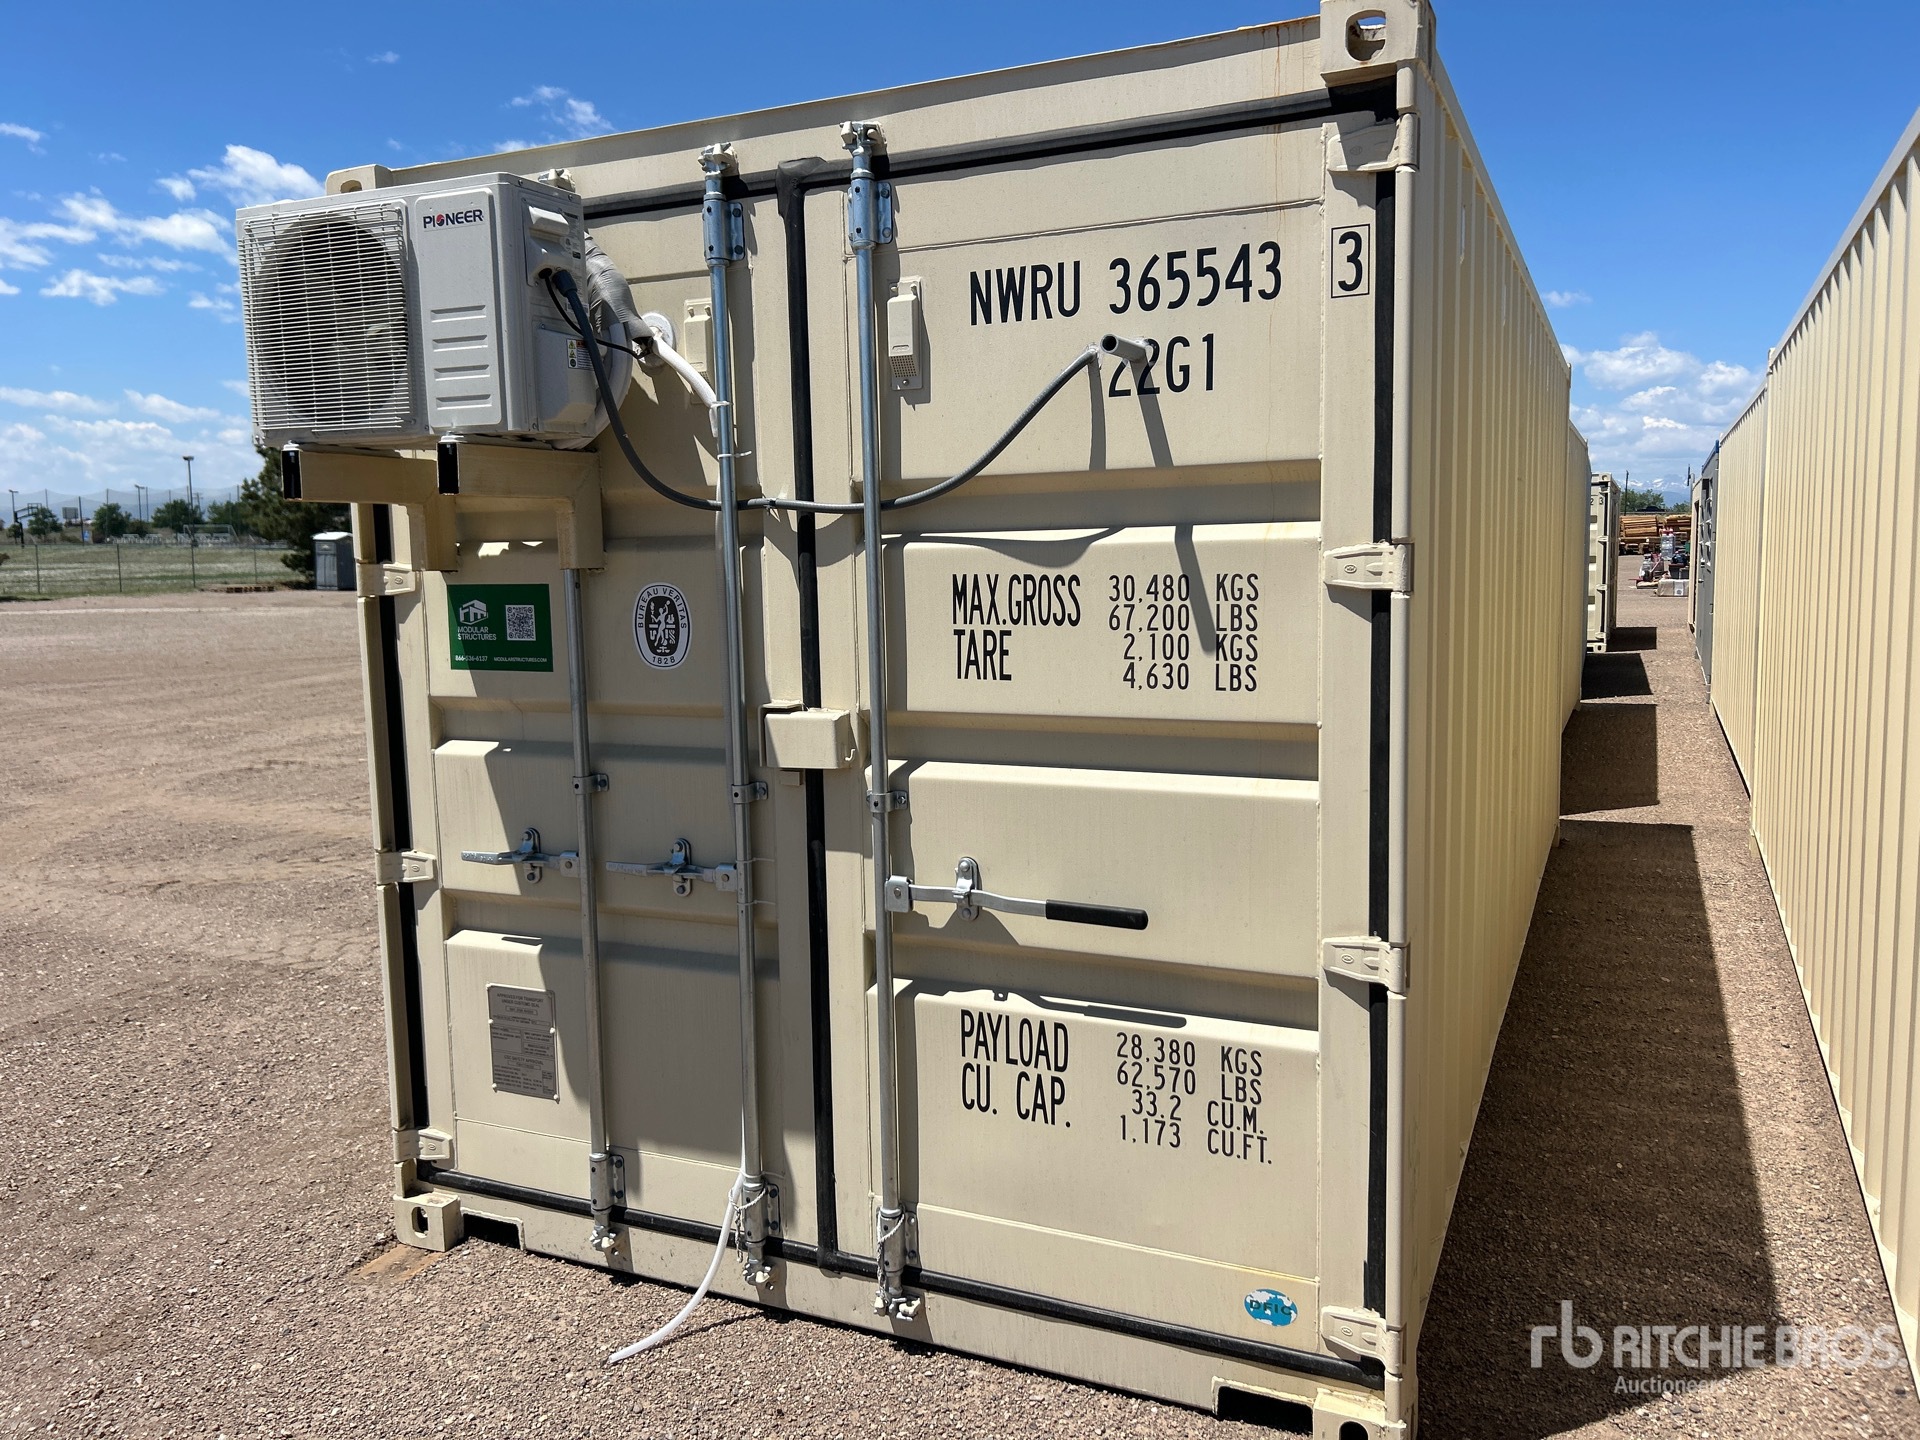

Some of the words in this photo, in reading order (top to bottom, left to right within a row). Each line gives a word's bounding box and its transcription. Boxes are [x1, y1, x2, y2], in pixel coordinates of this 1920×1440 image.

[423, 209, 484, 229] PIONEER
[970, 261, 1081, 326] NWRU
[1109, 240, 1282, 317] 365543
[1337, 230, 1364, 293] 3
[638, 587, 659, 628] BUREAU
[662, 587, 687, 629] VERITAS
[952, 573, 1081, 627] MAX.GROSS
[1108, 573, 1190, 603] 30,480
[1216, 573, 1259, 602] KGS
[1108, 603, 1190, 632] 67,200
[1216, 603, 1258, 632] LBS
[457, 633, 497, 641] STRUCTURES
[953, 628, 1012, 681] TARE
[1123, 632, 1190, 662] 2,100
[1215, 633, 1258, 662] KGS
[652, 655, 676, 665] 1828
[1122, 661, 1190, 690] 4,630
[1215, 663, 1257, 692] LBS
[960, 1009, 1069, 1073] PAYLOAD
[1116, 1032, 1196, 1067] 28,380
[1221, 1045, 1263, 1077] KGS
[962, 1062, 997, 1115] CU.
[1016, 1071, 1070, 1128] CAP.
[1131, 1089, 1182, 1121] 33.2
[1207, 1100, 1265, 1135] CU.M.
[1117, 1060, 1196, 1095] 62,570
[1221, 1074, 1262, 1105] LBS
[1120, 1114, 1181, 1148] 1,173
[1207, 1128, 1273, 1165] CU.FT.
[1249, 1299, 1292, 1316] DFIC
